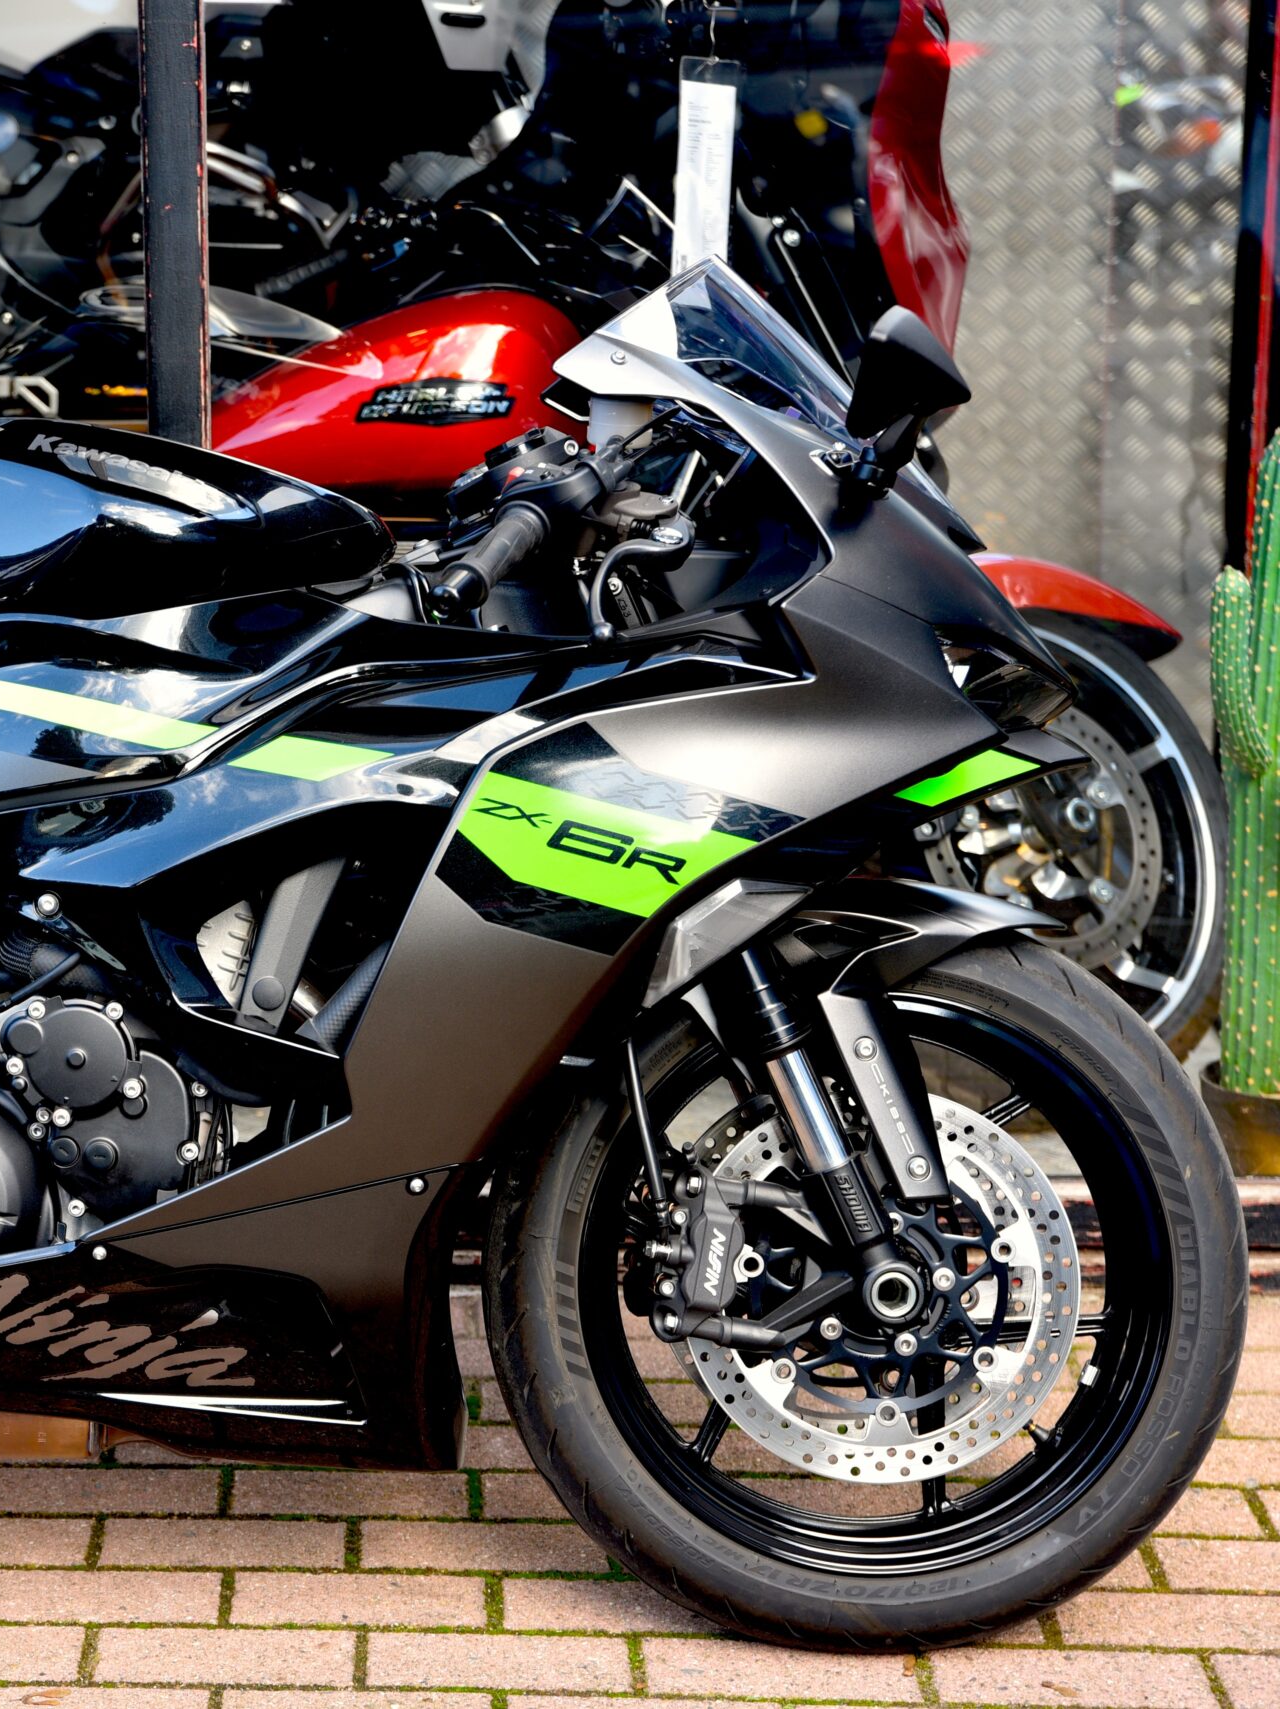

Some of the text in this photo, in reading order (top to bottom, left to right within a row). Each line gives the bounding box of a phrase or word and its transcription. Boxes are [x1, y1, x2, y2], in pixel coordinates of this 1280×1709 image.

[27, 433, 205, 487] Kawasa
[833, 1173, 874, 1233] SHOWA
[703, 1227, 727, 1297] NISSIN
[1174, 1223, 1200, 1362] DIABLO
[1120, 1373, 1185, 1478] ROSSO
